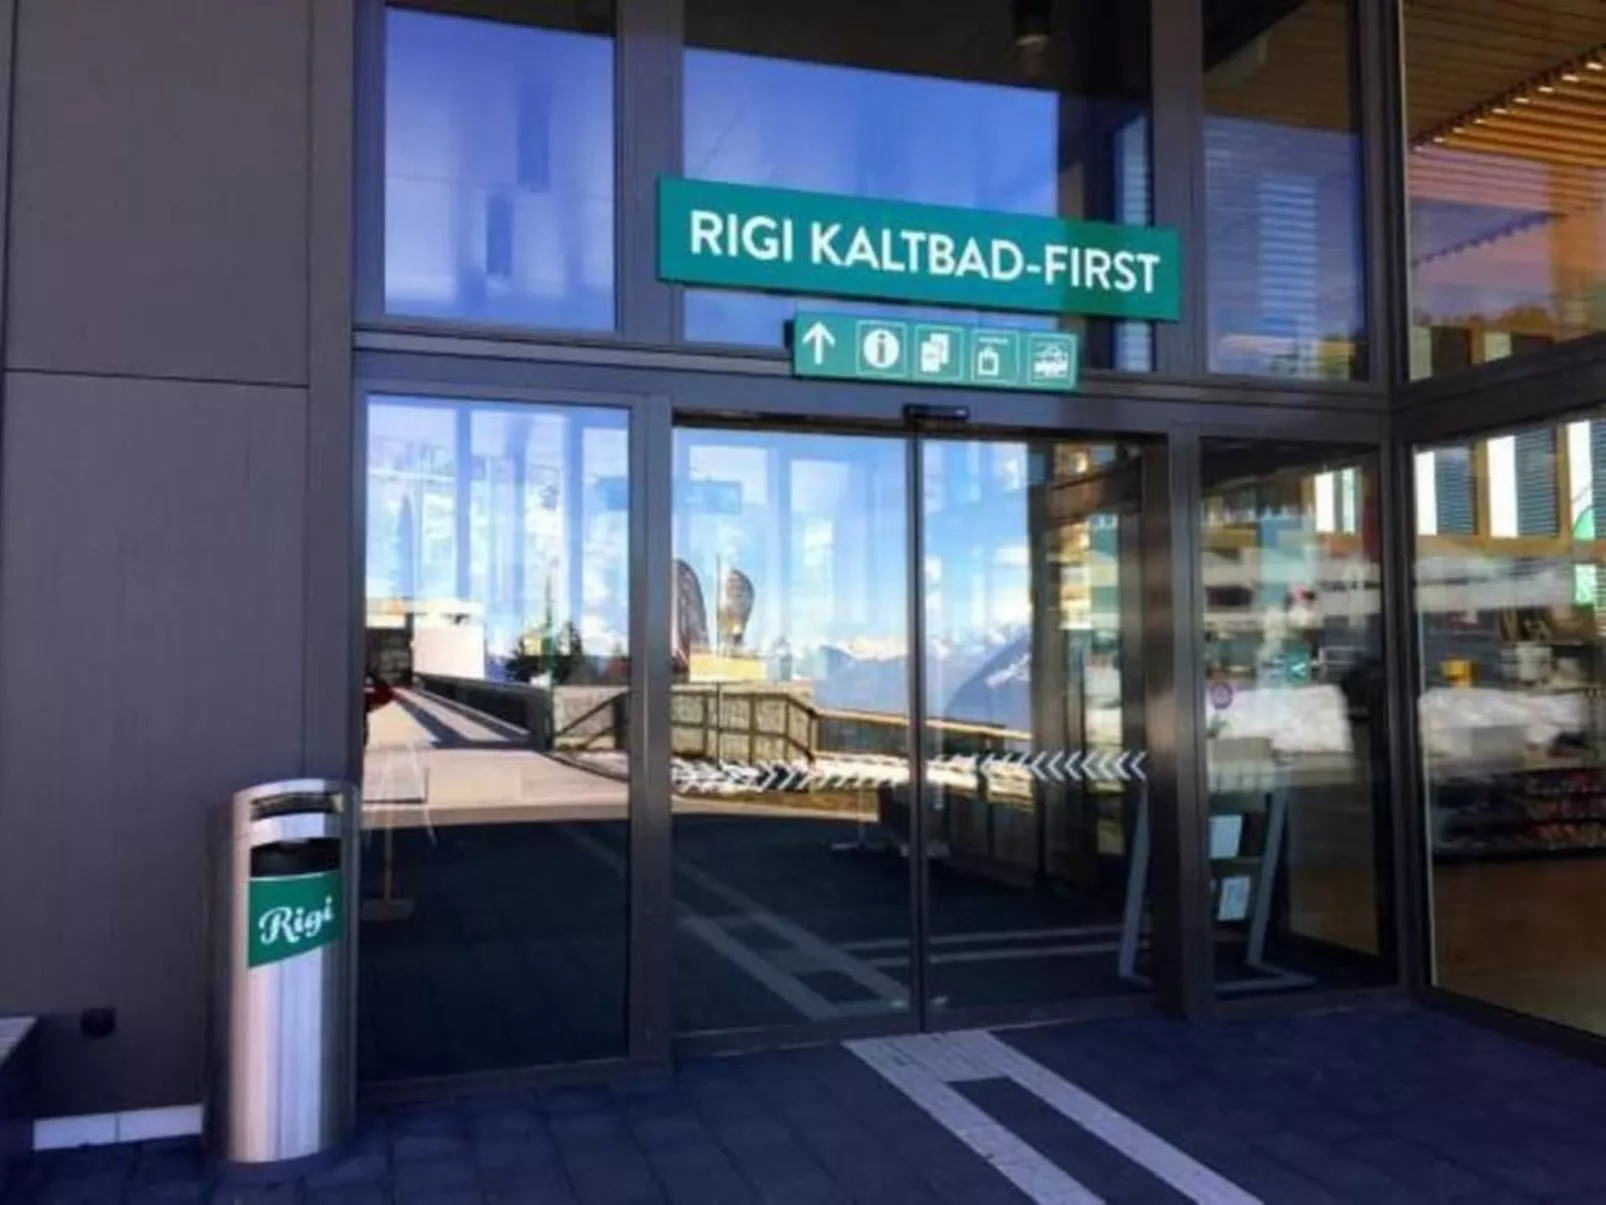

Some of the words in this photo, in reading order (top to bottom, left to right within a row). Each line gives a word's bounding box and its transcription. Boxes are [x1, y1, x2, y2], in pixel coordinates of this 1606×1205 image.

[690, 210, 793, 262] RIGI
[811, 222, 1161, 293] KALTBAD-FIRST
[258, 895, 333, 945] Rigi
